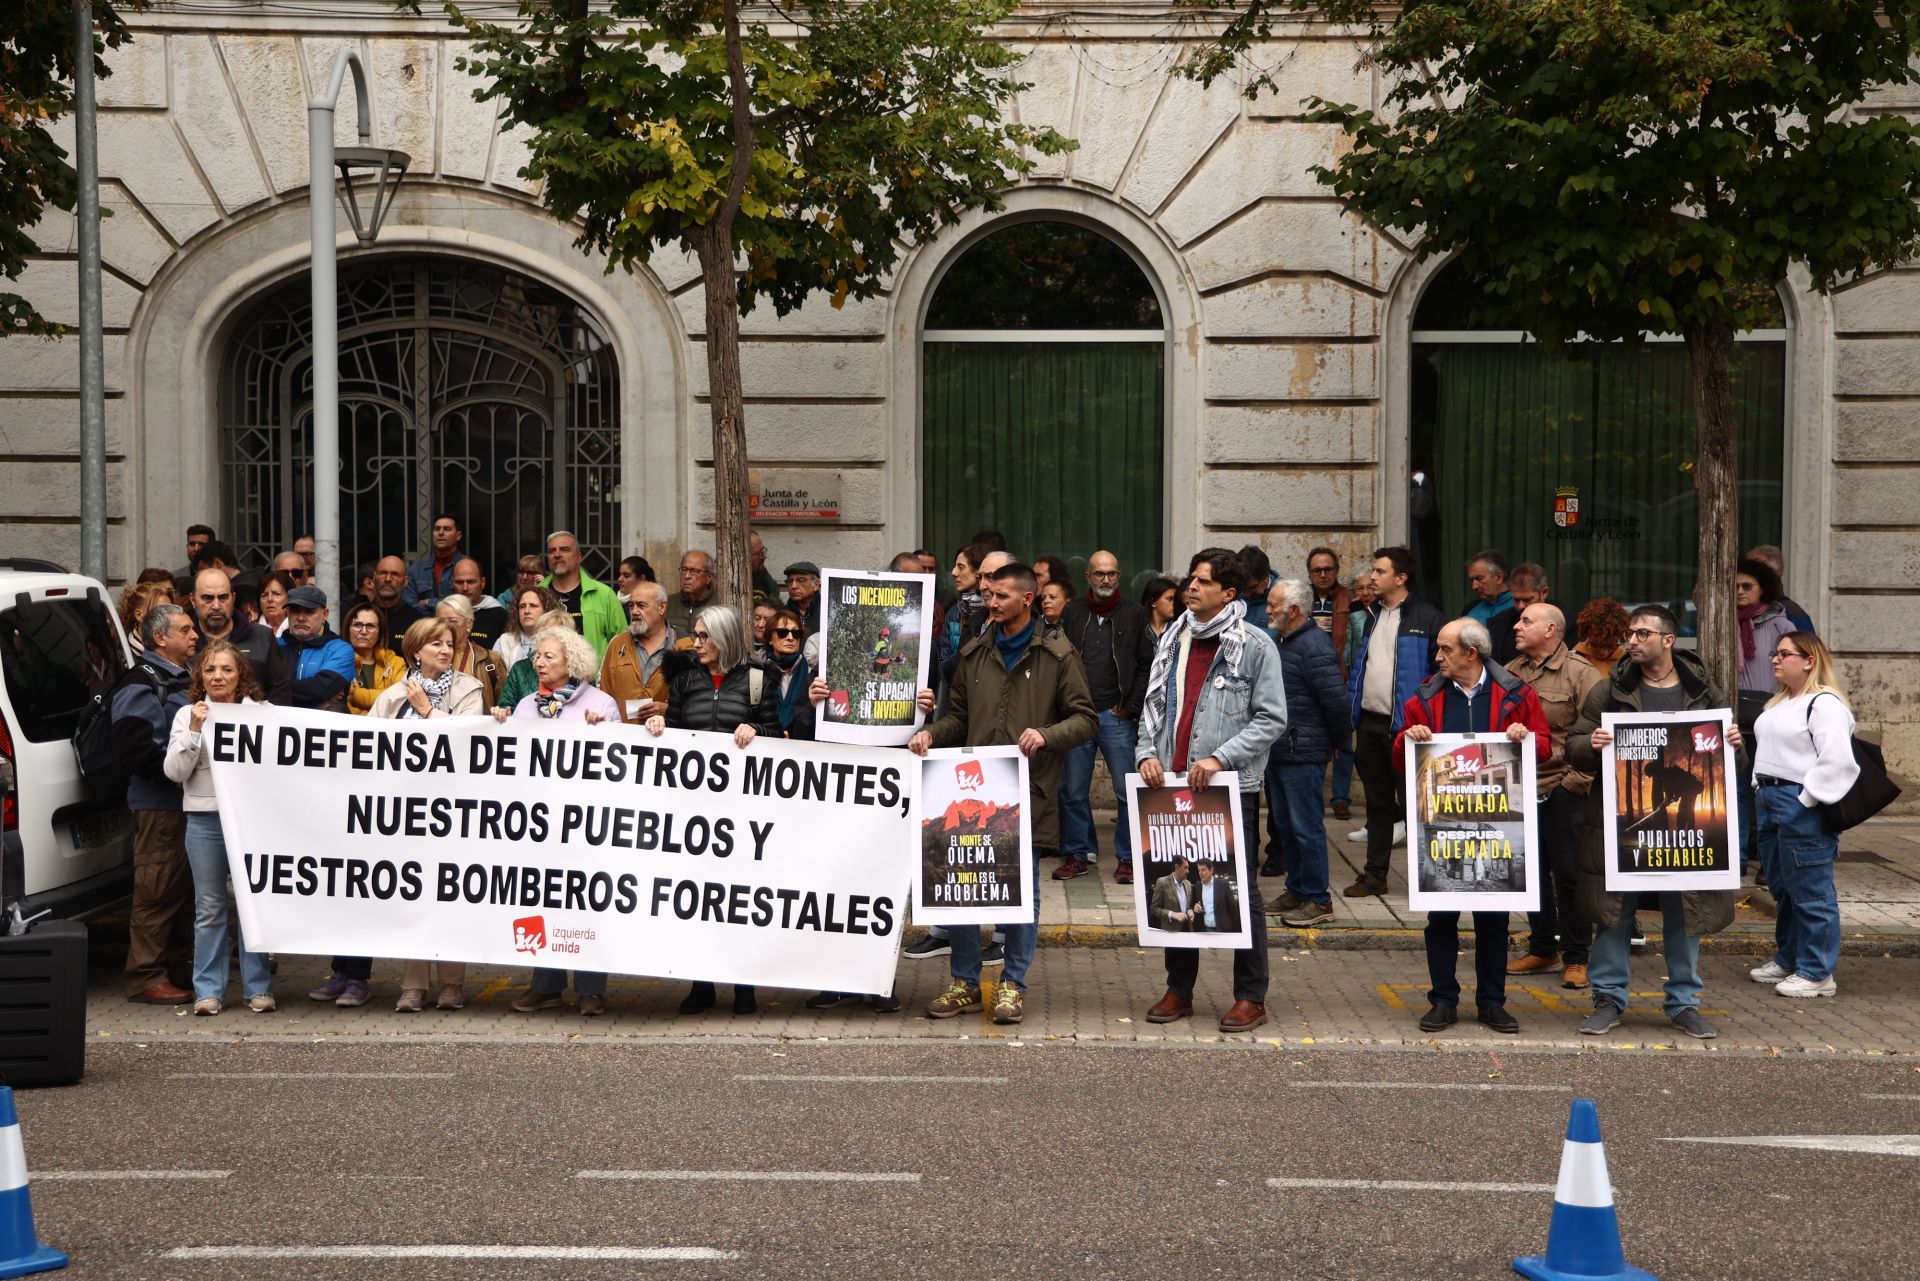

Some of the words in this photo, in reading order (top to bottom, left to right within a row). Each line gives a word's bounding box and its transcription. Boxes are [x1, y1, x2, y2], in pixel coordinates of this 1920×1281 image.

[762, 489, 792, 498] Junta
[795, 490, 808, 498] de
[762, 498, 799, 508] Castilla
[803, 501, 808, 509] y
[812, 499, 838, 508] León
[1624, 515, 1640, 526] de
[842, 586, 858, 604] LOS
[859, 586, 906, 606] INCENDIOS
[866, 682, 876, 700] SE
[880, 682, 915, 700] APAGAN
[860, 700, 872, 718] EN
[874, 700, 913, 719] INVIERNO
[1616, 728, 1668, 746] BOMBEROS
[1617, 747, 1658, 760] FORESTALES
[214, 722, 263, 764] EN
[277, 726, 455, 773] DEFENSA
[469, 735, 518, 776] DE
[529, 738, 730, 792] NUESTROS
[742, 756, 910, 818] MONTES,
[1436, 784, 1502, 794] PRIMERO
[1432, 794, 1508, 813] VACIADA
[347, 794, 549, 842] NUESTROS
[561, 804, 734, 858] PUEBLOS
[750, 820, 774, 860] Y
[1148, 812, 1180, 825] QUIÑONES
[1184, 814, 1188, 824] Y
[951, 835, 958, 846] EL
[960, 835, 982, 846] MONTE
[982, 835, 992, 846] SE
[1148, 824, 1228, 862] DIMISION
[1436, 830, 1504, 840] DESPUES
[1638, 829, 1704, 848] PUBLICOS
[948, 846, 995, 866] QUEMA
[1430, 840, 1512, 861] QUEMADA
[1633, 849, 1640, 866] Y
[1648, 848, 1714, 866] ESTABLES
[948, 872, 956, 884] LA
[957, 872, 978, 884] JUNTA
[979, 872, 988, 884] ES
[989, 872, 996, 884] EL
[437, 862, 638, 914] BOMBEROS
[650, 876, 894, 936] FORESTALES
[934, 884, 1010, 902] PROBLEMA
[552, 926, 596, 941] izquierda
[552, 941, 580, 954] unida
